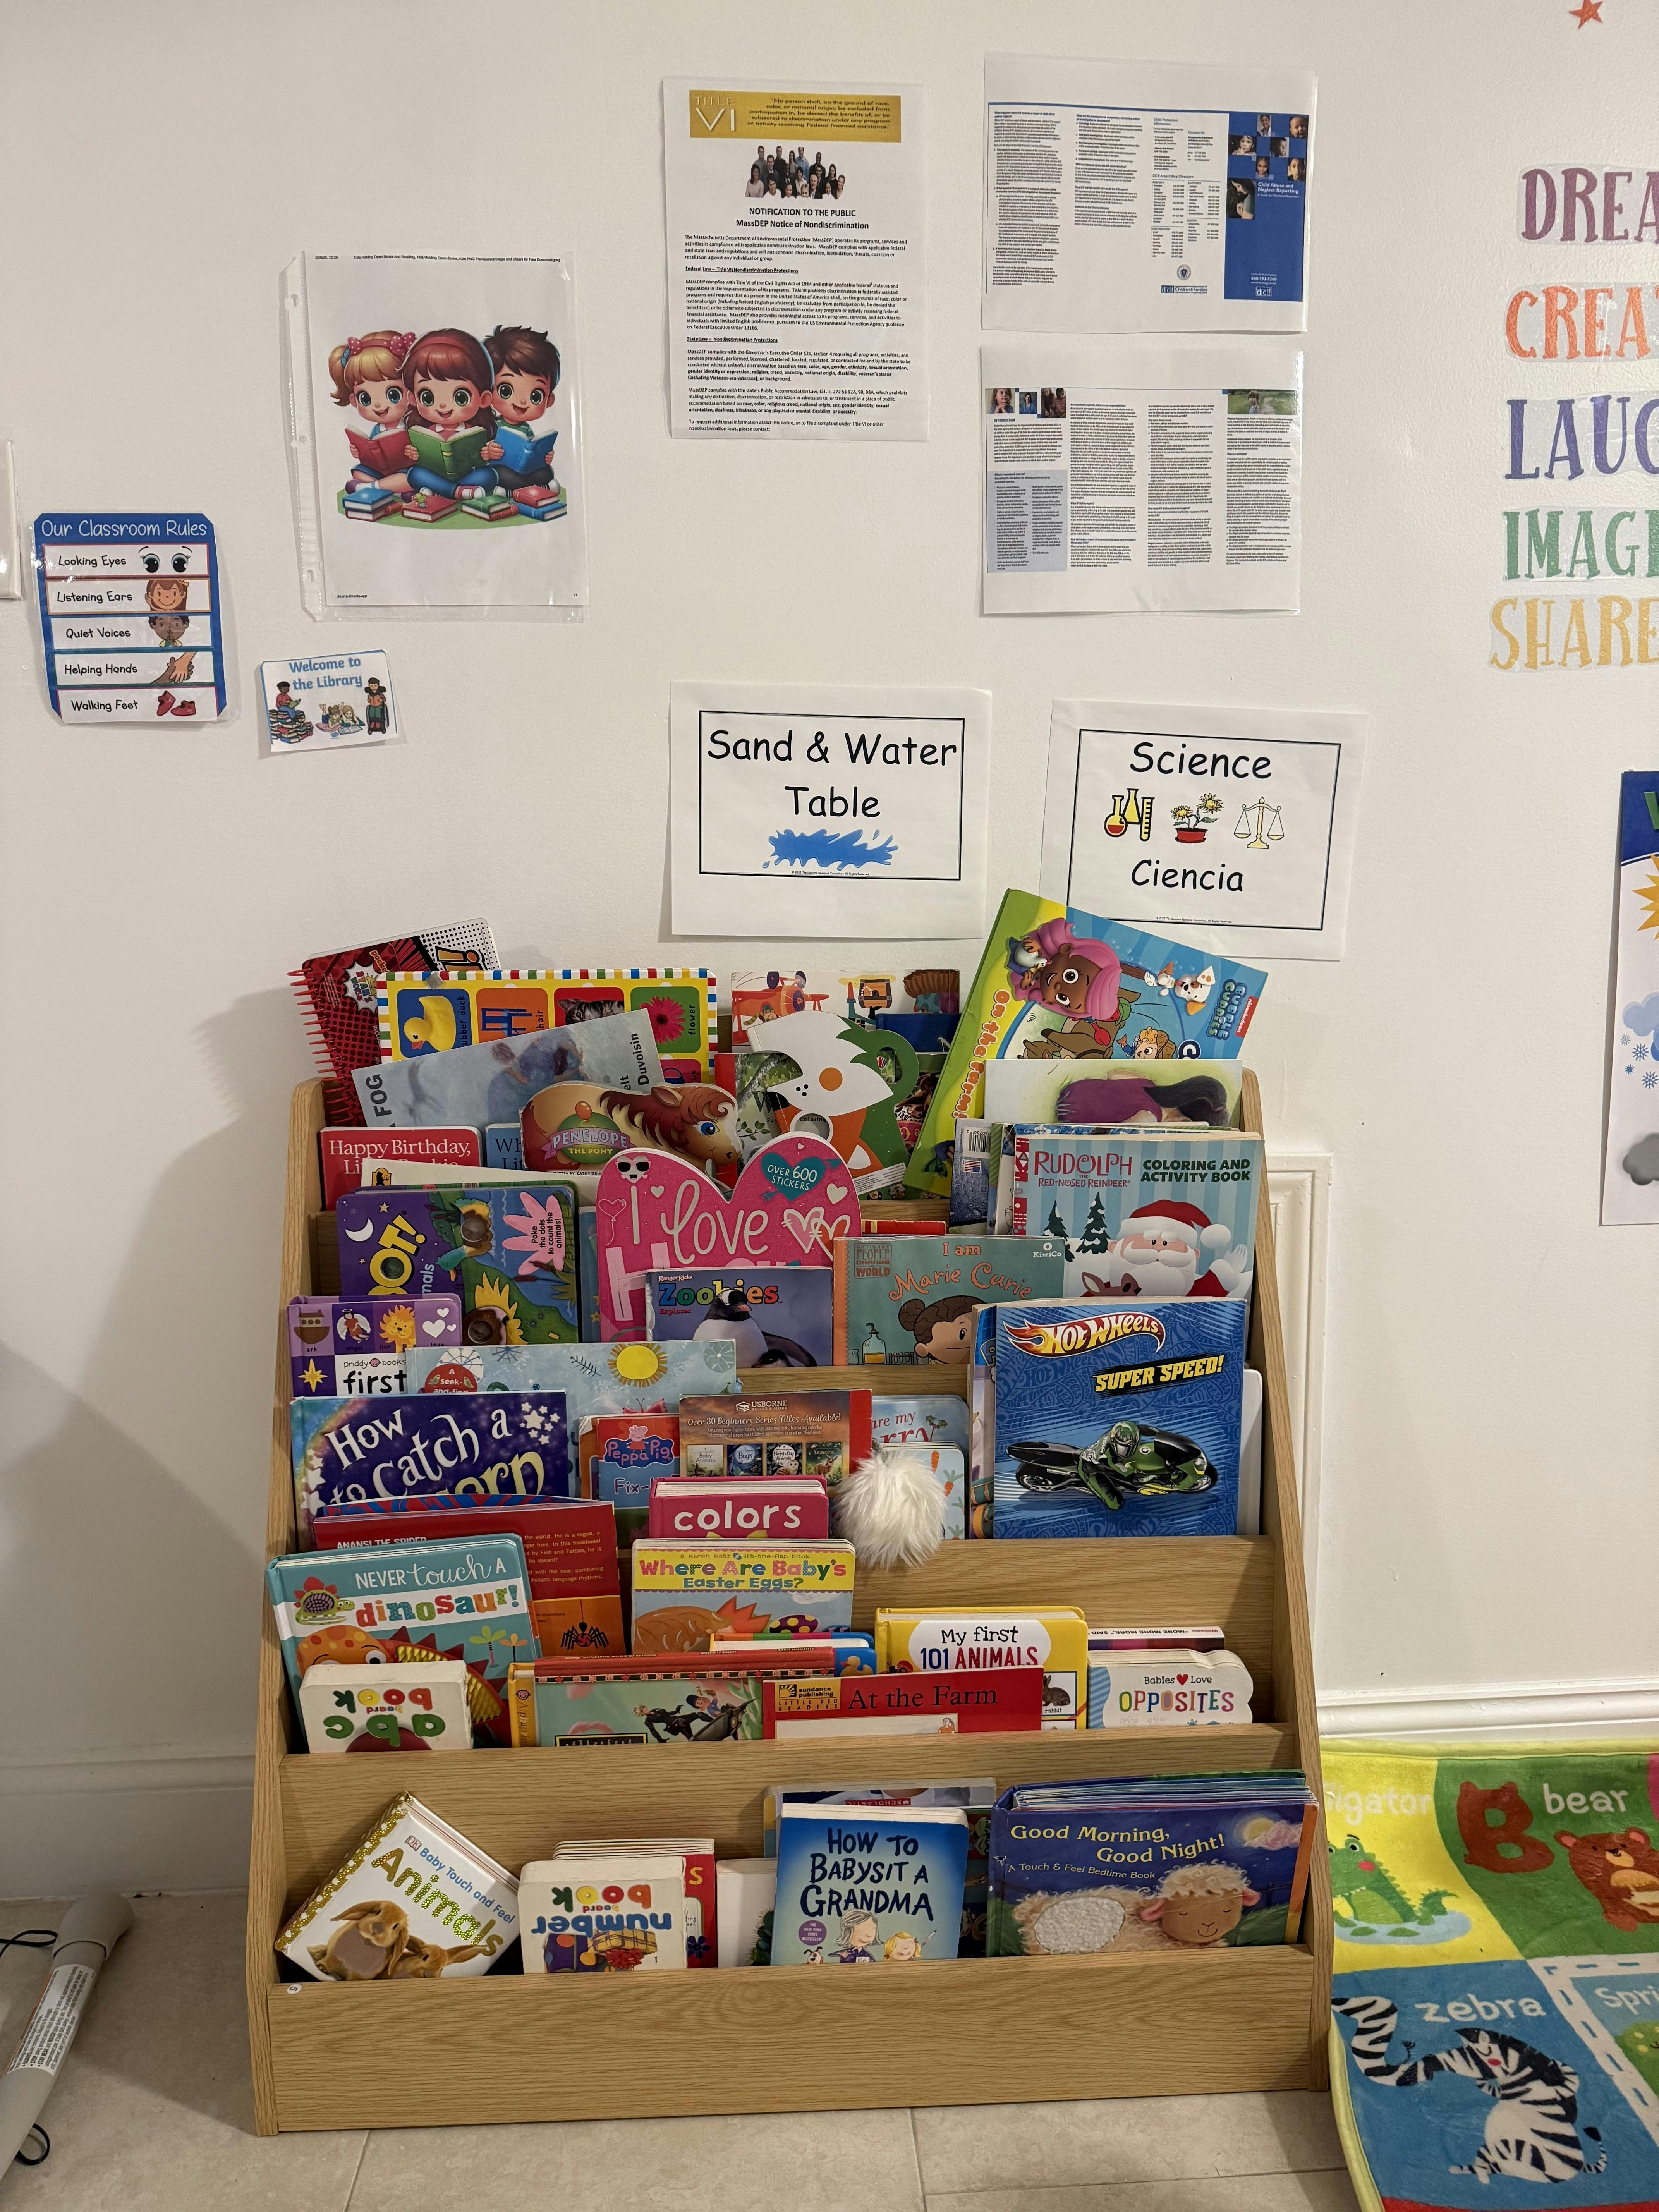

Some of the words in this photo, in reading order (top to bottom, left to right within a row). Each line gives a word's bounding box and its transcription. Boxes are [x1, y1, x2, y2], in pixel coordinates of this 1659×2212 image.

[696, 108, 735, 131] VI
[749, 207, 801, 216] NOTIFICATION
[803, 208, 813, 216] TO
[814, 208, 828, 216] THE
[830, 209, 856, 217] PUBLIC
[736, 219, 768, 227] MassDEP
[804, 220, 869, 230] Nondiscrimination
[1506, 285, 1659, 359] CREA
[41, 520, 73, 537] Our
[79, 519, 160, 537] Classroom
[166, 520, 207, 536] Rules
[58, 555, 97, 567] Looking
[101, 556, 127, 567] Eyes
[57, 592, 103, 604] Listening
[106, 592, 132, 601] Ears
[66, 628, 93, 639] Quiet
[98, 628, 131, 638] Voices
[64, 664, 102, 676] Helping
[106, 665, 137, 675] Hands
[289, 660, 344, 673] Welcome
[349, 658, 361, 667] to
[292, 679, 313, 690] the
[317, 676, 362, 688] Library
[71, 700, 112, 712] Walking
[116, 700, 137, 710] Feet
[707, 730, 792, 763] Sand
[807, 731, 829, 763] &
[844, 732, 957, 767] Water
[1130, 742, 1272, 780] Science
[784, 786, 880, 819] Table
[1131, 859, 1245, 893] Ciencia
[1208, 982, 1235, 1036] GUPPIES
[1218, 986, 1245, 1038] BUBBLE
[1237, 999, 1252, 1033] nickelodeon
[631, 1033, 650, 1085] Duvoisin
[366, 1073, 392, 1117] FOG
[330, 1140, 388, 1158] Happy
[392, 1139, 471, 1157] Birthday,
[552, 1128, 628, 1149] PENELOPE
[768, 1164, 790, 1177] OVER
[793, 1166, 817, 1182] 600
[1034, 1151, 1132, 1176] RUDOLPH
[1142, 1160, 1216, 1171] COLORING
[1219, 1159, 1250, 1171] AND
[771, 1175, 810, 1191] STICKERS
[1038, 1177, 1086, 1187] RED-NOSED
[1141, 1171, 1208, 1182] ACTIVITY
[1211, 1171, 1250, 1182] BOOK
[630, 1185, 640, 1244] I
[661, 1179, 768, 1264] love
[857, 1248, 890, 1261] PEOPLE
[943, 1242, 949, 1256] I
[955, 1245, 981, 1256] am
[856, 1267, 890, 1277] WORLD
[889, 1264, 961, 1301] Marie
[971, 1262, 1032, 1299] Curie
[344, 1360, 368, 1369] priddy
[1095, 1367, 1154, 1392] SUPER
[1159, 1355, 1224, 1382] SPEED!
[343, 1370, 406, 1393] first
[718, 1417, 753, 1426] Beginners
[756, 1416, 776, 1424] Series
[779, 1415, 799, 1423] Titles
[801, 1413, 841, 1423] Available!
[325, 1409, 404, 1470] How
[330, 1484, 366, 1505] to
[373, 1414, 479, 1496] Catch
[491, 1408, 512, 1439] a
[606, 1442, 647, 1469] Peppa
[650, 1439, 671, 1459] Pig
[674, 1500, 801, 1530] colors
[356, 1570, 407, 1590] NEVER
[408, 1554, 492, 1586] touch
[496, 1558, 506, 1574] A
[640, 1560, 716, 1576] Where
[722, 1560, 766, 1575] Are
[772, 1559, 846, 1582] Baby's
[684, 1577, 745, 1589] Easter
[749, 1577, 804, 1592] Eggs?
[356, 1584, 519, 1627] dinosaur!
[942, 1628, 967, 1645] My
[973, 1626, 1018, 1644] first
[920, 1648, 950, 1670] 101
[955, 1647, 1038, 1668] ANIMALS
[1144, 1675, 1175, 1685] Babies
[1190, 1675, 1212, 1685] Love
[333, 1688, 433, 1713] book
[366, 1706, 403, 1714] board
[848, 1689, 872, 1711] At
[886, 1687, 923, 1709] the
[933, 1685, 998, 1707] Farm
[1119, 1689, 1234, 1713] OPPOSITES
[323, 1714, 446, 1747] abc
[1544, 1783, 1629, 1814] bear
[828, 1827, 878, 1854] HOW
[886, 1835, 918, 1856] TO
[1010, 1825, 1068, 1840] Good
[1077, 1826, 1170, 1843] Morning,
[1097, 1848, 1152, 1863] Good
[1162, 1833, 1225, 1860] Night!
[809, 1853, 908, 1885] BABYSIT
[914, 1865, 928, 1885] A
[1064, 1864, 1085, 1873] Feel
[1087, 1867, 1127, 1878] Bedtime
[1130, 1870, 1155, 1879] Book
[419, 1846, 445, 1872] Baby
[446, 1866, 474, 1894] Touch
[473, 1889, 494, 1908] and
[489, 1899, 514, 1924] Feel
[371, 1848, 505, 1956] Animals
[551, 1884, 651, 1913] book
[582, 1905, 620, 1913] board
[800, 1885, 933, 1921] GRANDMA
[531, 1911, 672, 1937] number
[1415, 1996, 1546, 2023] zebra
